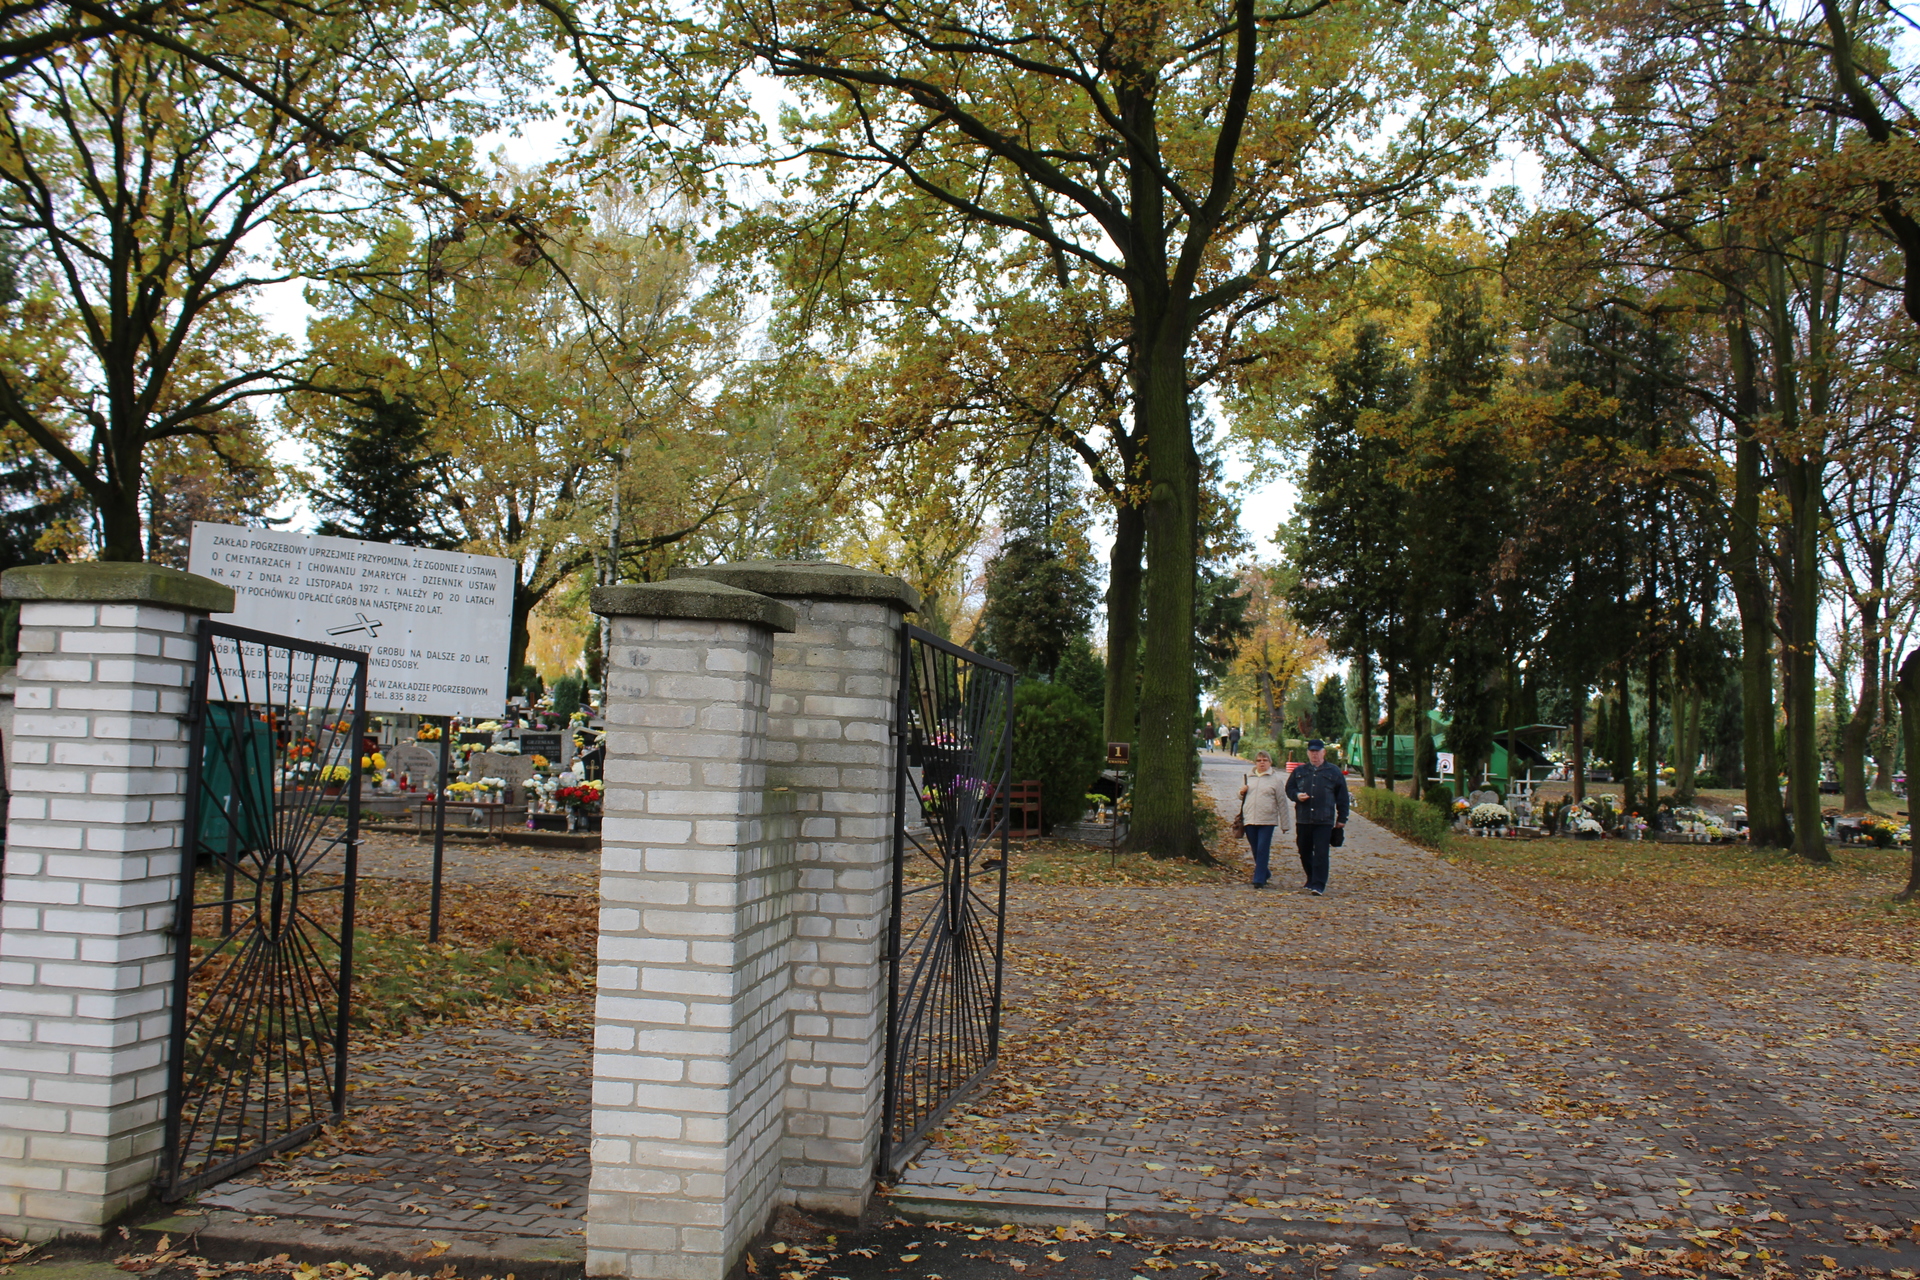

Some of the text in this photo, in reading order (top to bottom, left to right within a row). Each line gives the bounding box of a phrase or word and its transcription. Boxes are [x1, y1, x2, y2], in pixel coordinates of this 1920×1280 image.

[213, 536, 498, 578] ZAKŁAD POGRZEBOWY UPRZEJMIE PRZYPOMINA, ŻE ZGODNIE Z USTAWĄ
[212, 552, 218, 561] O
[226, 553, 291, 568] CMENTARZACH
[297, 562, 302, 570] I
[308, 562, 356, 576] CHOWANIU
[362, 569, 406, 582] ZMARŁYCH
[422, 576, 463, 588] DZIENNIK
[468, 581, 497, 591] USTAW
[210, 568, 224, 577] NR
[230, 570, 240, 578] 47
[247, 571, 253, 580] Z
[260, 572, 282, 583] DNIA
[288, 576, 299, 585] 22
[306, 578, 353, 591] LISTOPADA
[359, 584, 378, 594] 1972
[396, 588, 427, 598] NALEŻY
[432, 591, 444, 600] PO
[449, 593, 460, 602] 20
[466, 594, 495, 606] LATACH
[248, 586, 296, 600] POCHÓWKU
[298, 591, 333, 604] OPŁACIĆ
[335, 594, 358, 606] GRÓB
[360, 598, 372, 608] NA
[373, 600, 413, 612] NASTĘPNE
[415, 604, 425, 613] 20
[427, 606, 443, 615] LAT.
[377, 646, 405, 656] GROBU
[410, 650, 422, 658] NA
[426, 650, 456, 661] DALSZE
[460, 654, 470, 662] 20
[391, 660, 419, 670] OSOBY.
[379, 680, 386, 688] W
[387, 680, 430, 692] ZAKŁADZIE
[432, 684, 488, 696] POGRZEBOWYM
[374, 691, 387, 699] tel.
[390, 692, 403, 700] 835
[406, 693, 416, 701] 88
[418, 694, 427, 702] 22
[1115, 746, 1122, 757] 1
